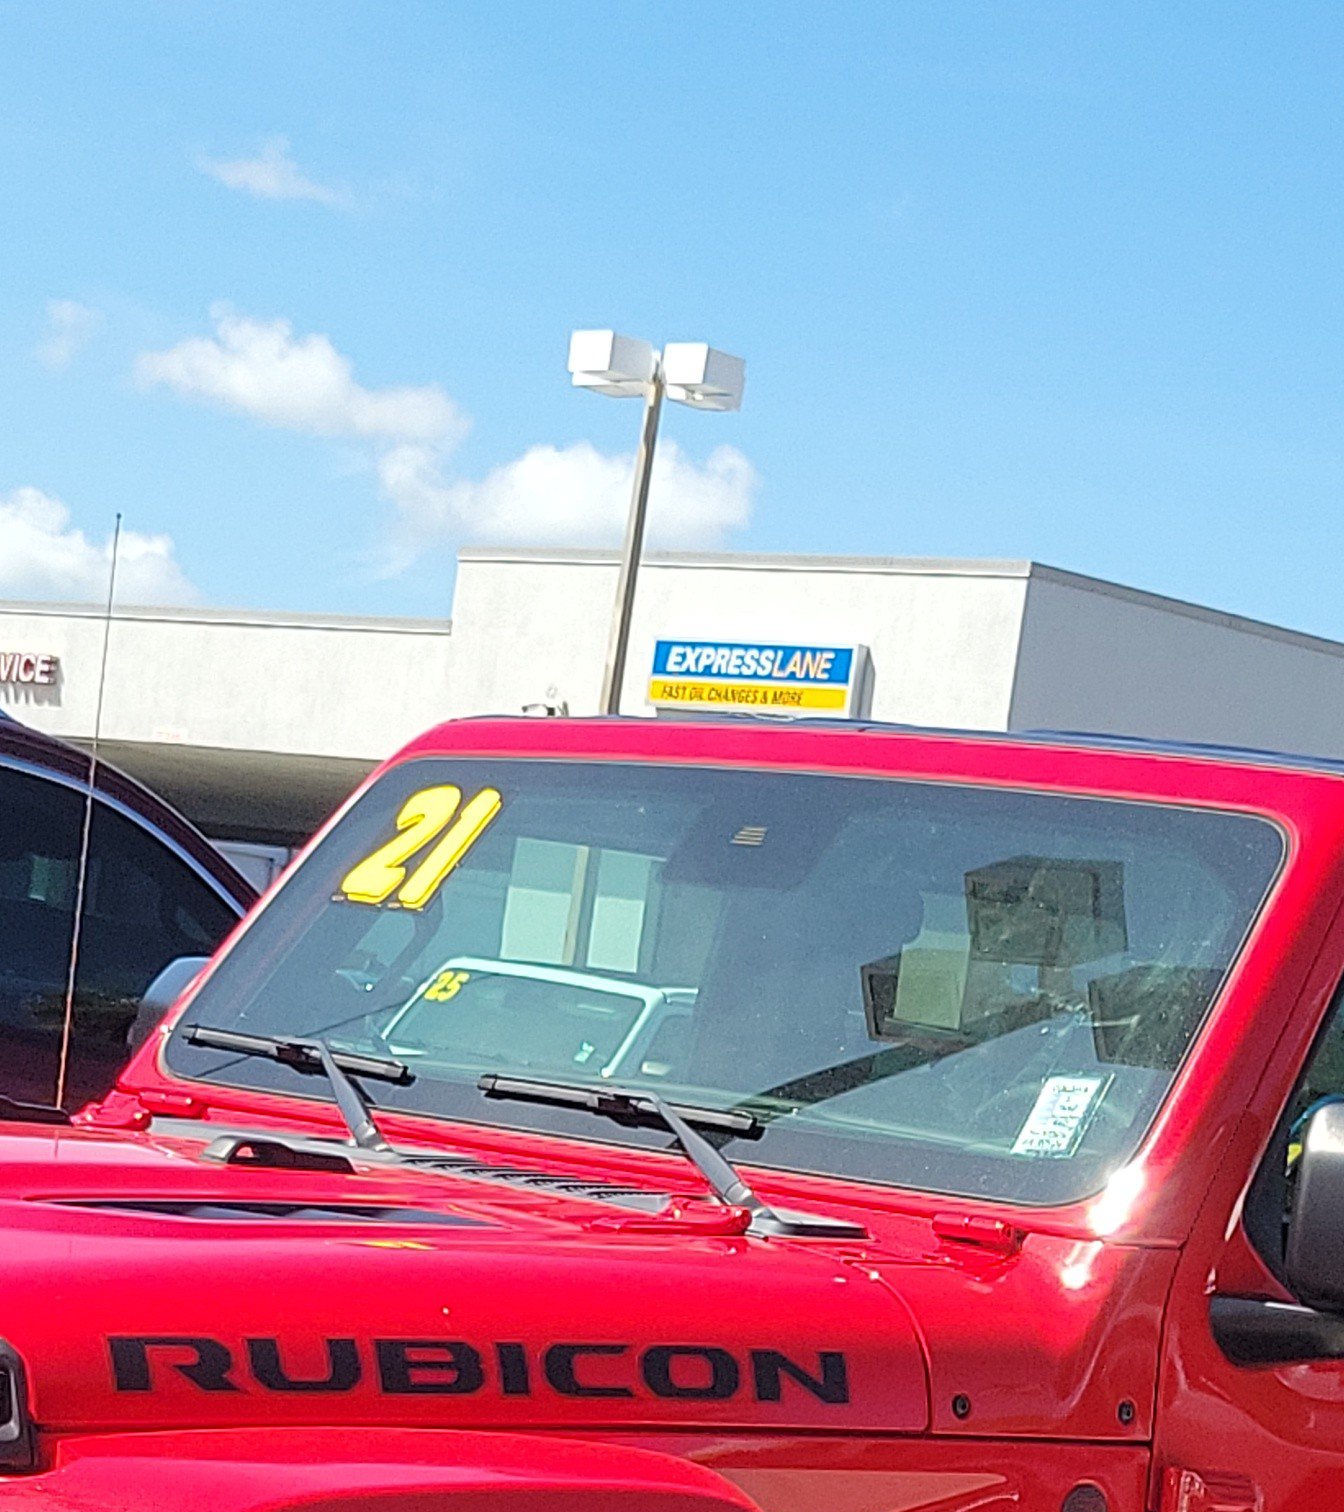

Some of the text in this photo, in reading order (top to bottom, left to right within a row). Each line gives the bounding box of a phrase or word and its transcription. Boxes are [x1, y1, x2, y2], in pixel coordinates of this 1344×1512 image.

[660, 685, 686, 700] FAST
[707, 688, 758, 705] CHANGES
[771, 691, 803, 707] MORE
[341, 783, 504, 910] 21
[104, 1334, 851, 1405] RUBICON
